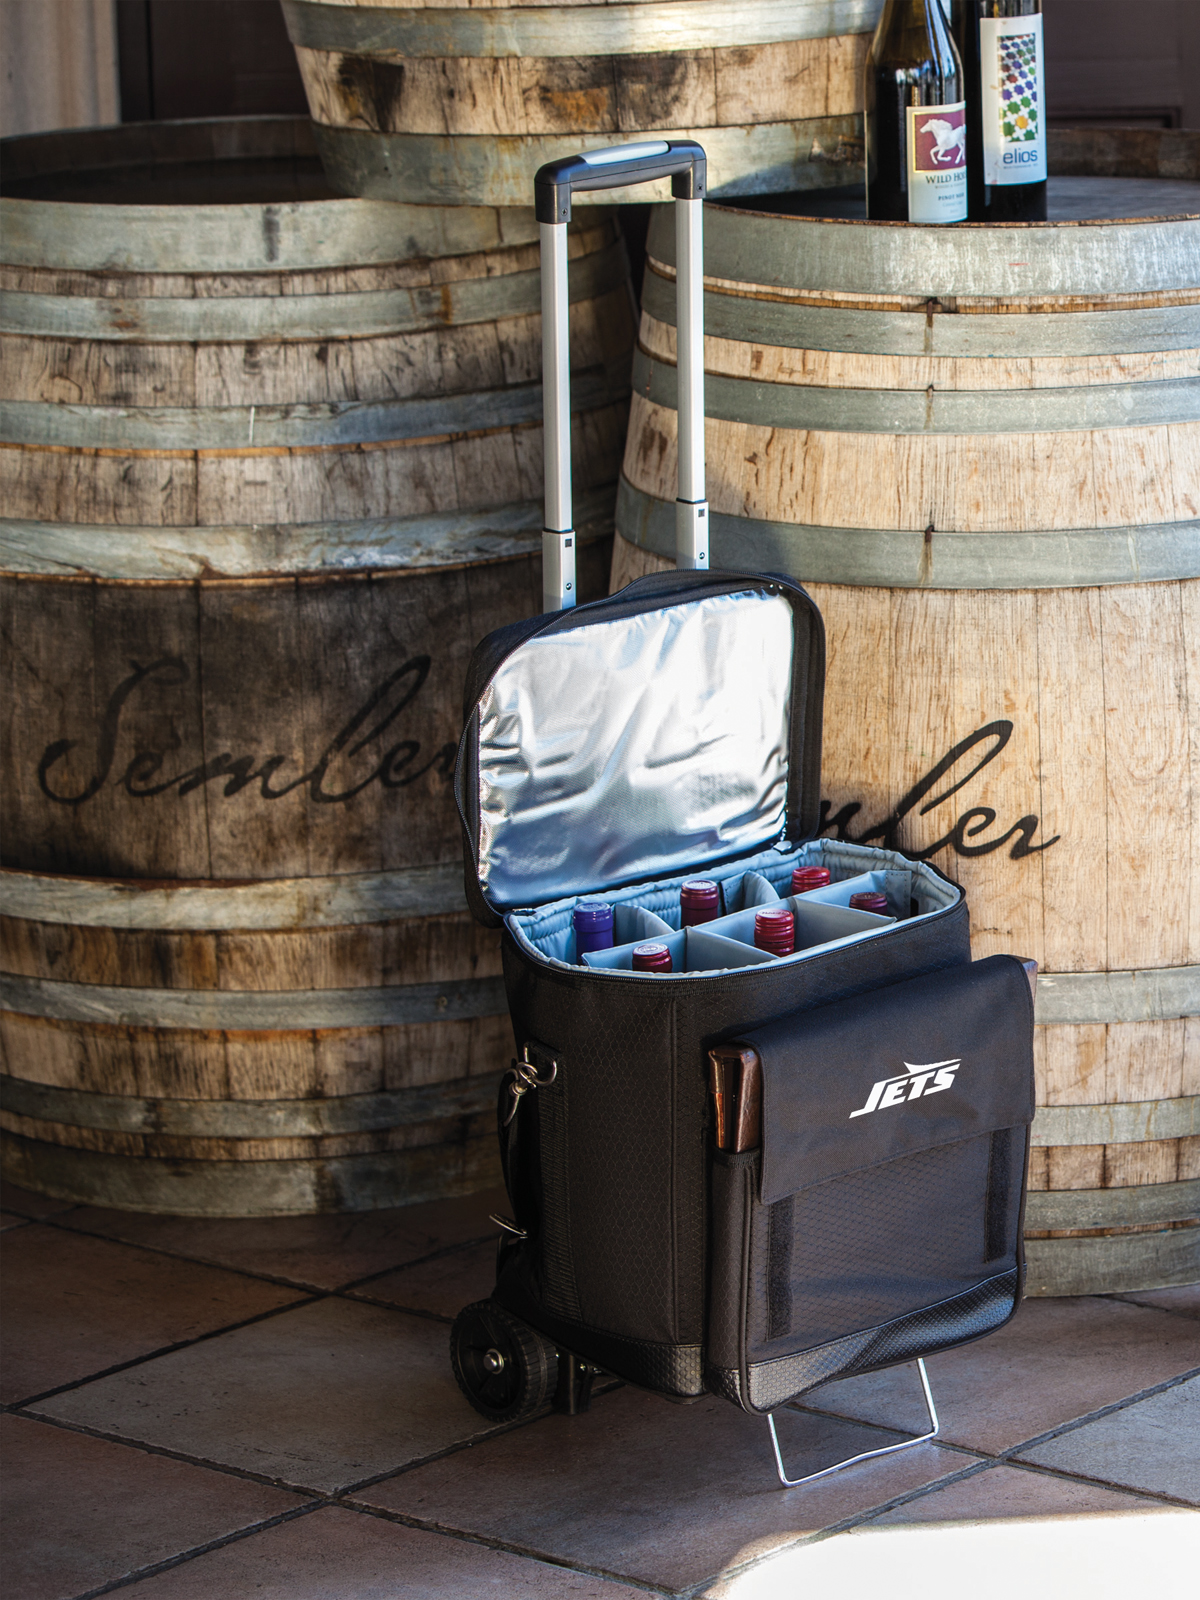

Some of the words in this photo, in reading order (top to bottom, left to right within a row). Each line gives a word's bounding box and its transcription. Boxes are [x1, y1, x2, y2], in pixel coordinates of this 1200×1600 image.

[1003, 147, 1038, 164] elios
[925, 174, 952, 184] WILD
[848, 1058, 963, 1119] JETS
